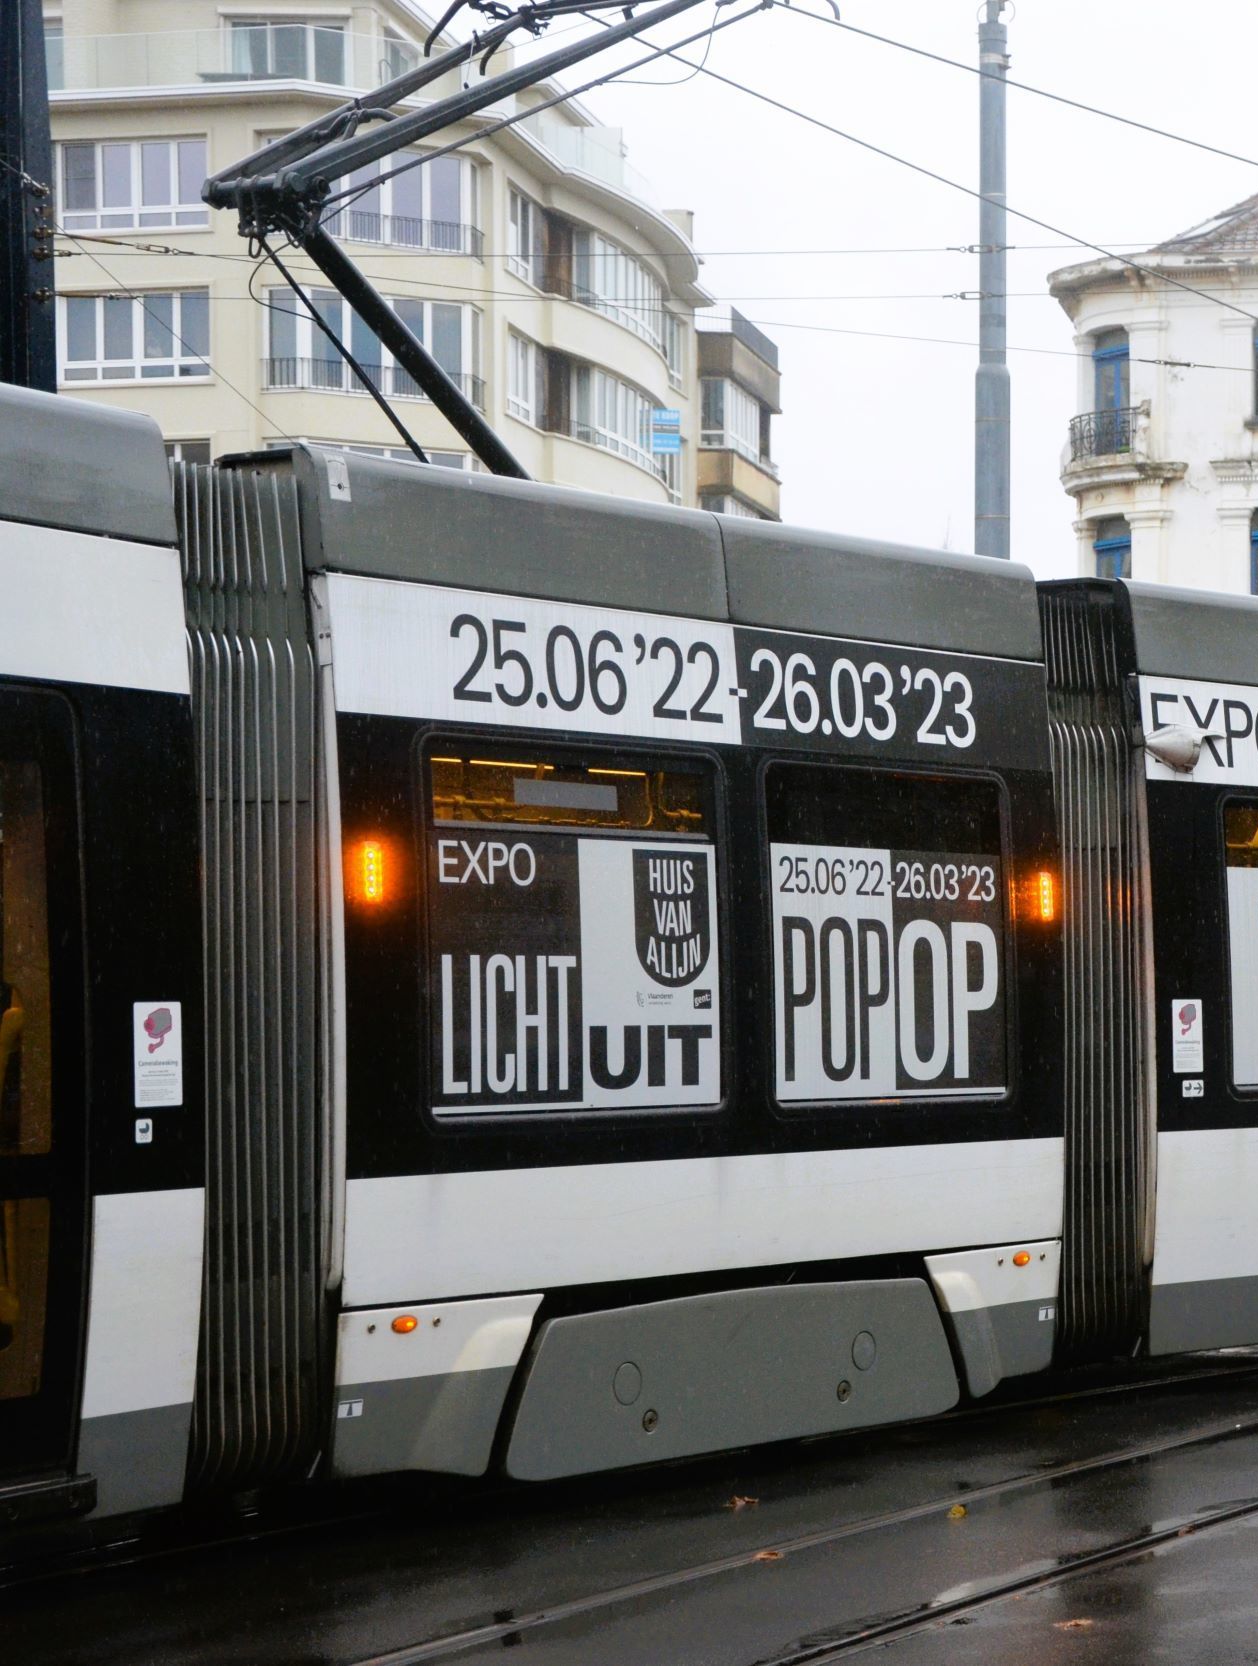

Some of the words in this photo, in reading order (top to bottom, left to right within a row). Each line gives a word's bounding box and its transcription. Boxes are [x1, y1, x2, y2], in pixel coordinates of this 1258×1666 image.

[437, 840, 537, 887] EXPO
[648, 858, 694, 895] HUIS
[653, 898, 692, 937] VAN
[646, 933, 701, 979] ALIJN
[441, 954, 577, 1095] LICHT
[589, 1025, 713, 1090] UIT
